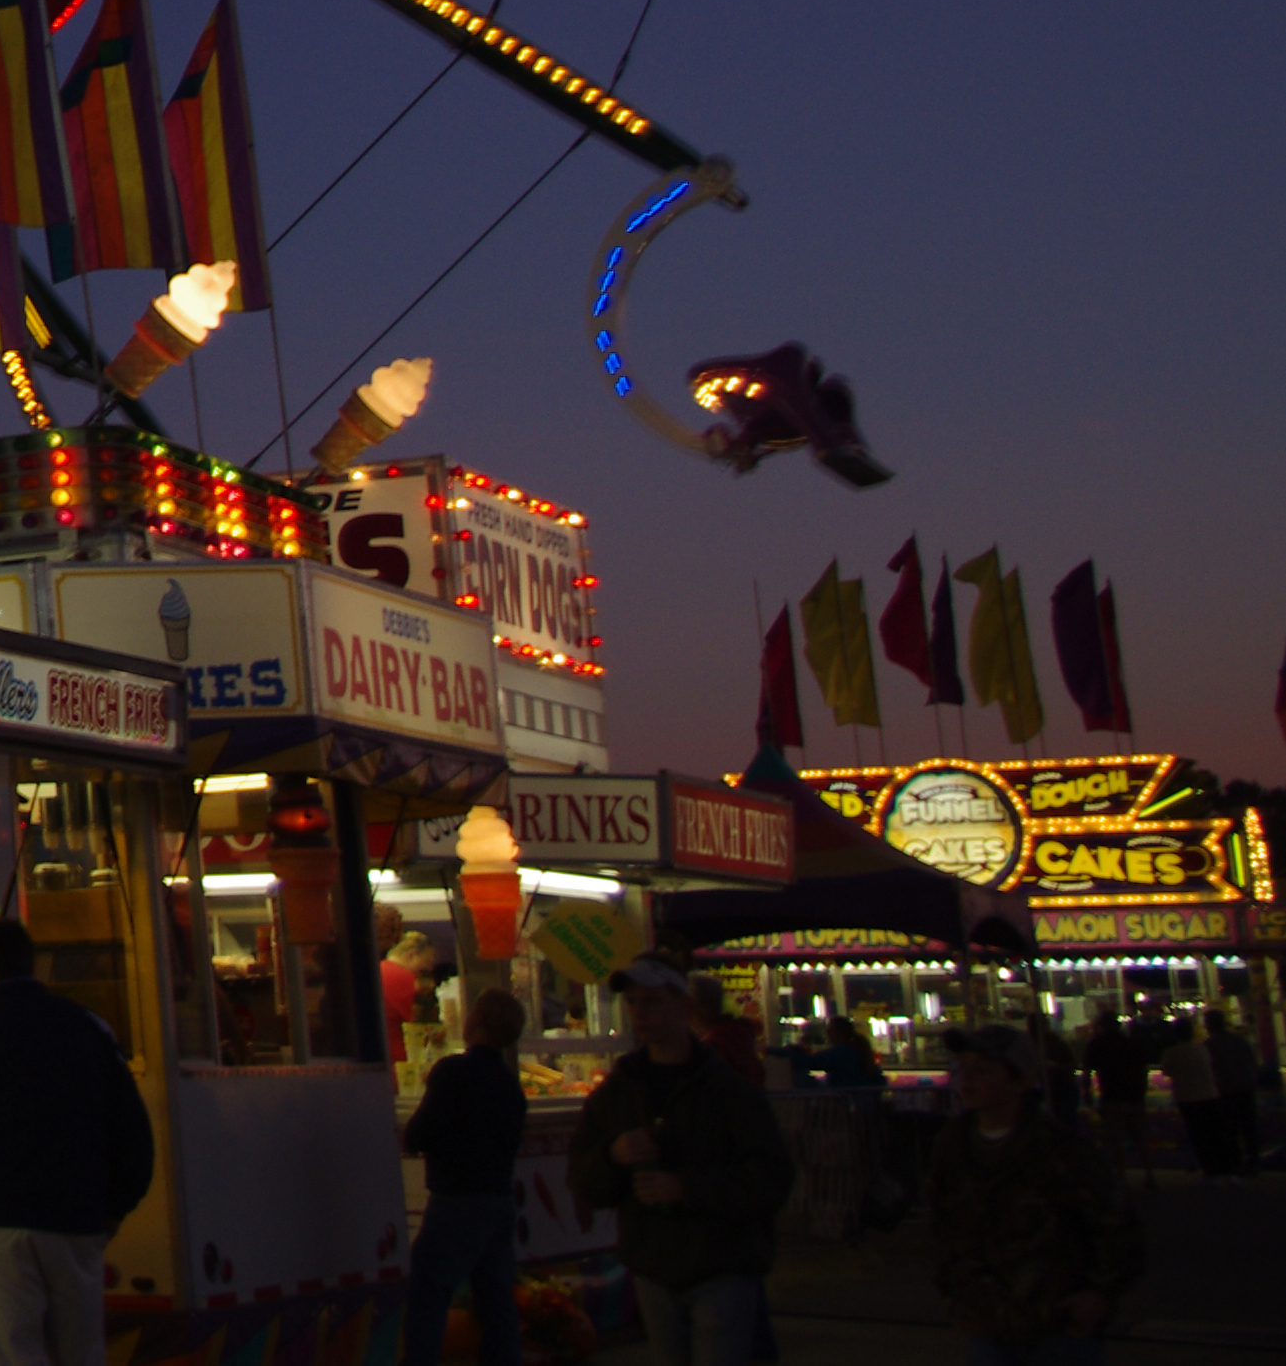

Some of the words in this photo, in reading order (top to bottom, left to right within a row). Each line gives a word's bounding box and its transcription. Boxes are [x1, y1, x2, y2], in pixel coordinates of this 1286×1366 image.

[322, 625, 422, 717] DAIRY
[429, 655, 493, 733] BAR
[47, 668, 121, 735] FRENCH
[123, 683, 170, 744] FRIES
[900, 799, 1006, 825] FUNNEL
[1030, 770, 1129, 811] DOUGH
[508, 792, 653, 845] RINKS
[674, 794, 741, 860] FRENCH
[744, 807, 790, 868] FRIES
[1034, 840, 1186, 886] CAKES
[1124, 911, 1228, 941] SUGAR
